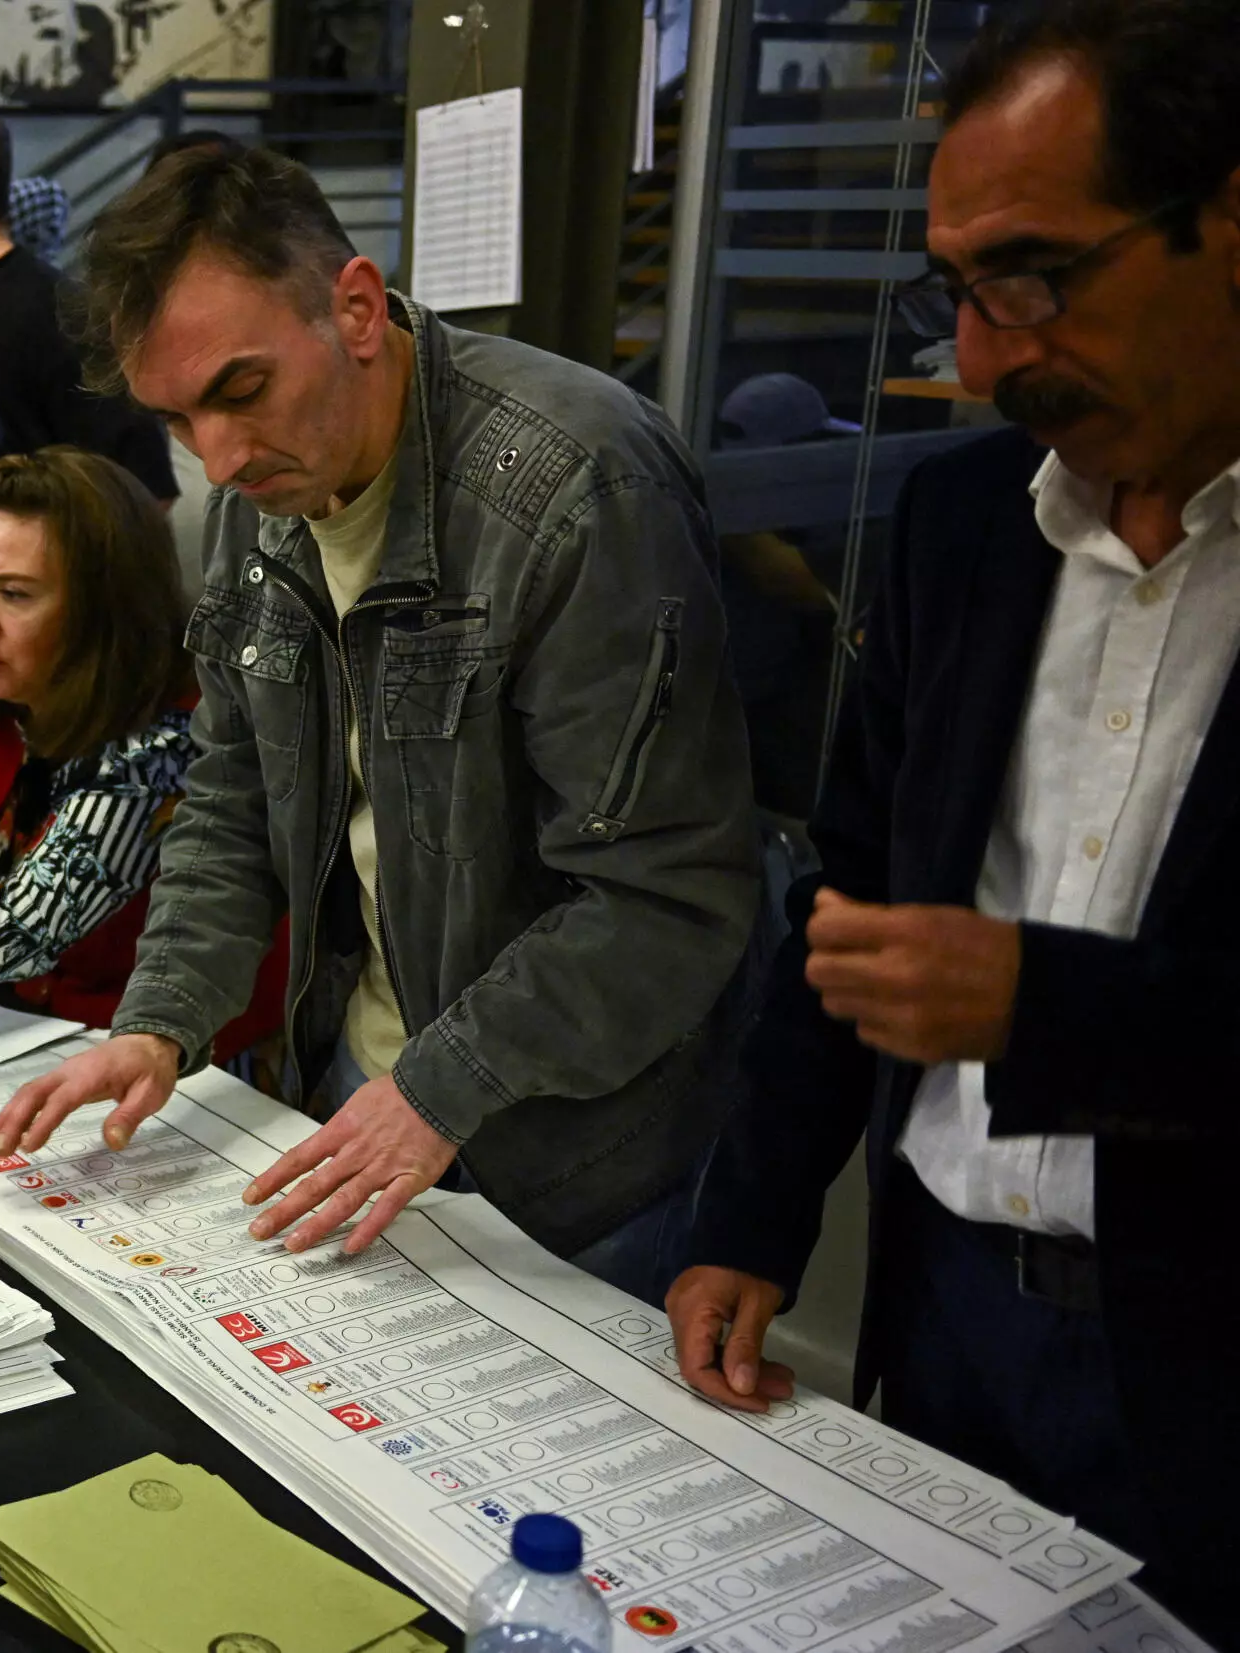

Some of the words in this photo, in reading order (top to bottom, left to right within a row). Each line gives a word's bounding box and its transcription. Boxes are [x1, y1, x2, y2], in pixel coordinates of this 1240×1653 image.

[245, 1313, 269, 1333] MHP
[186, 1339, 206, 1358] GENEL
[477, 1500, 511, 1525] SOL
[594, 1568, 625, 1589] TKP
